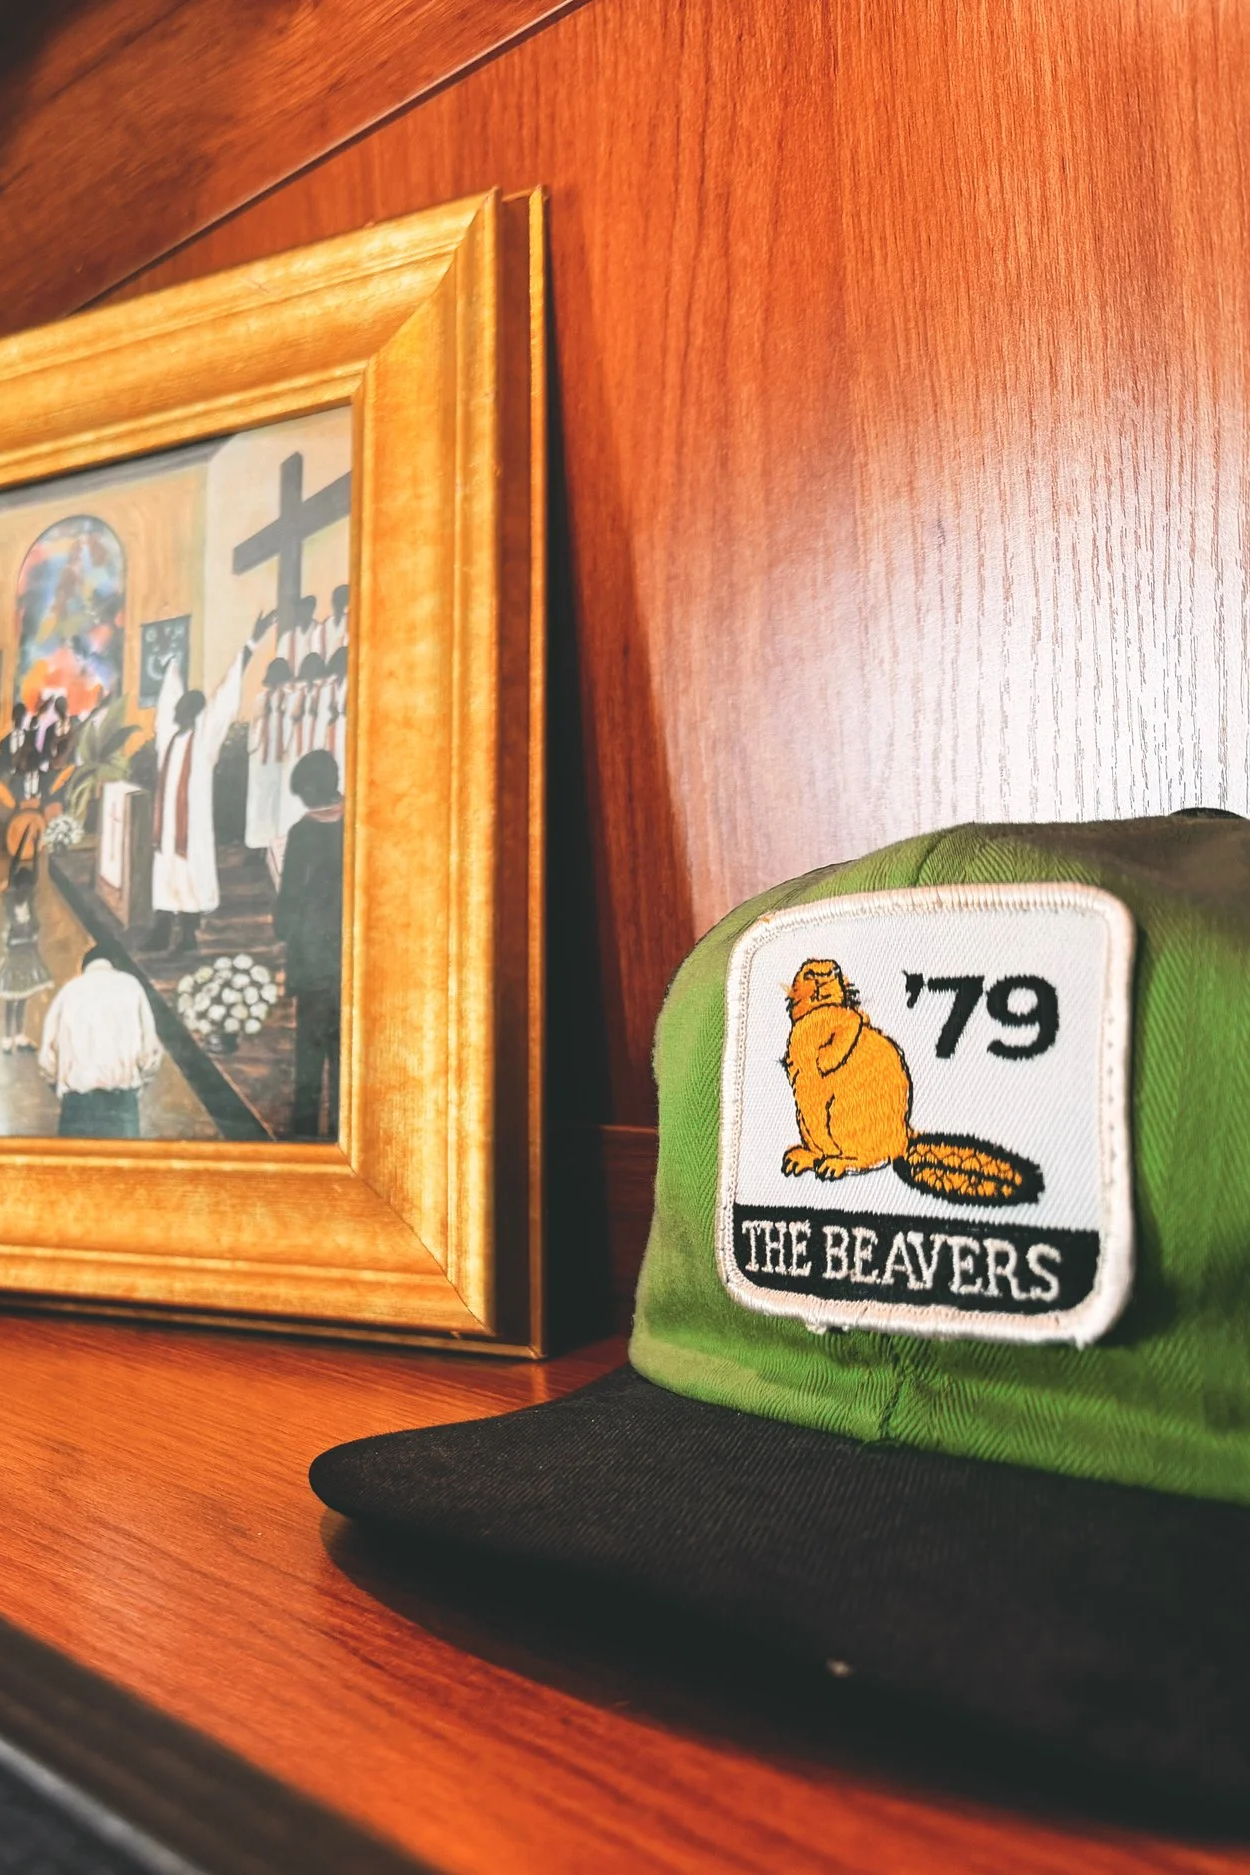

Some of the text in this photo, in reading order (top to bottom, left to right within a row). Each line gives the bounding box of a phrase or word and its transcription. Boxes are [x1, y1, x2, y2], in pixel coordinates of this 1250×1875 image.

[902, 970, 1059, 1060] '79
[742, 1220, 1061, 1300] THE BEAVERS
